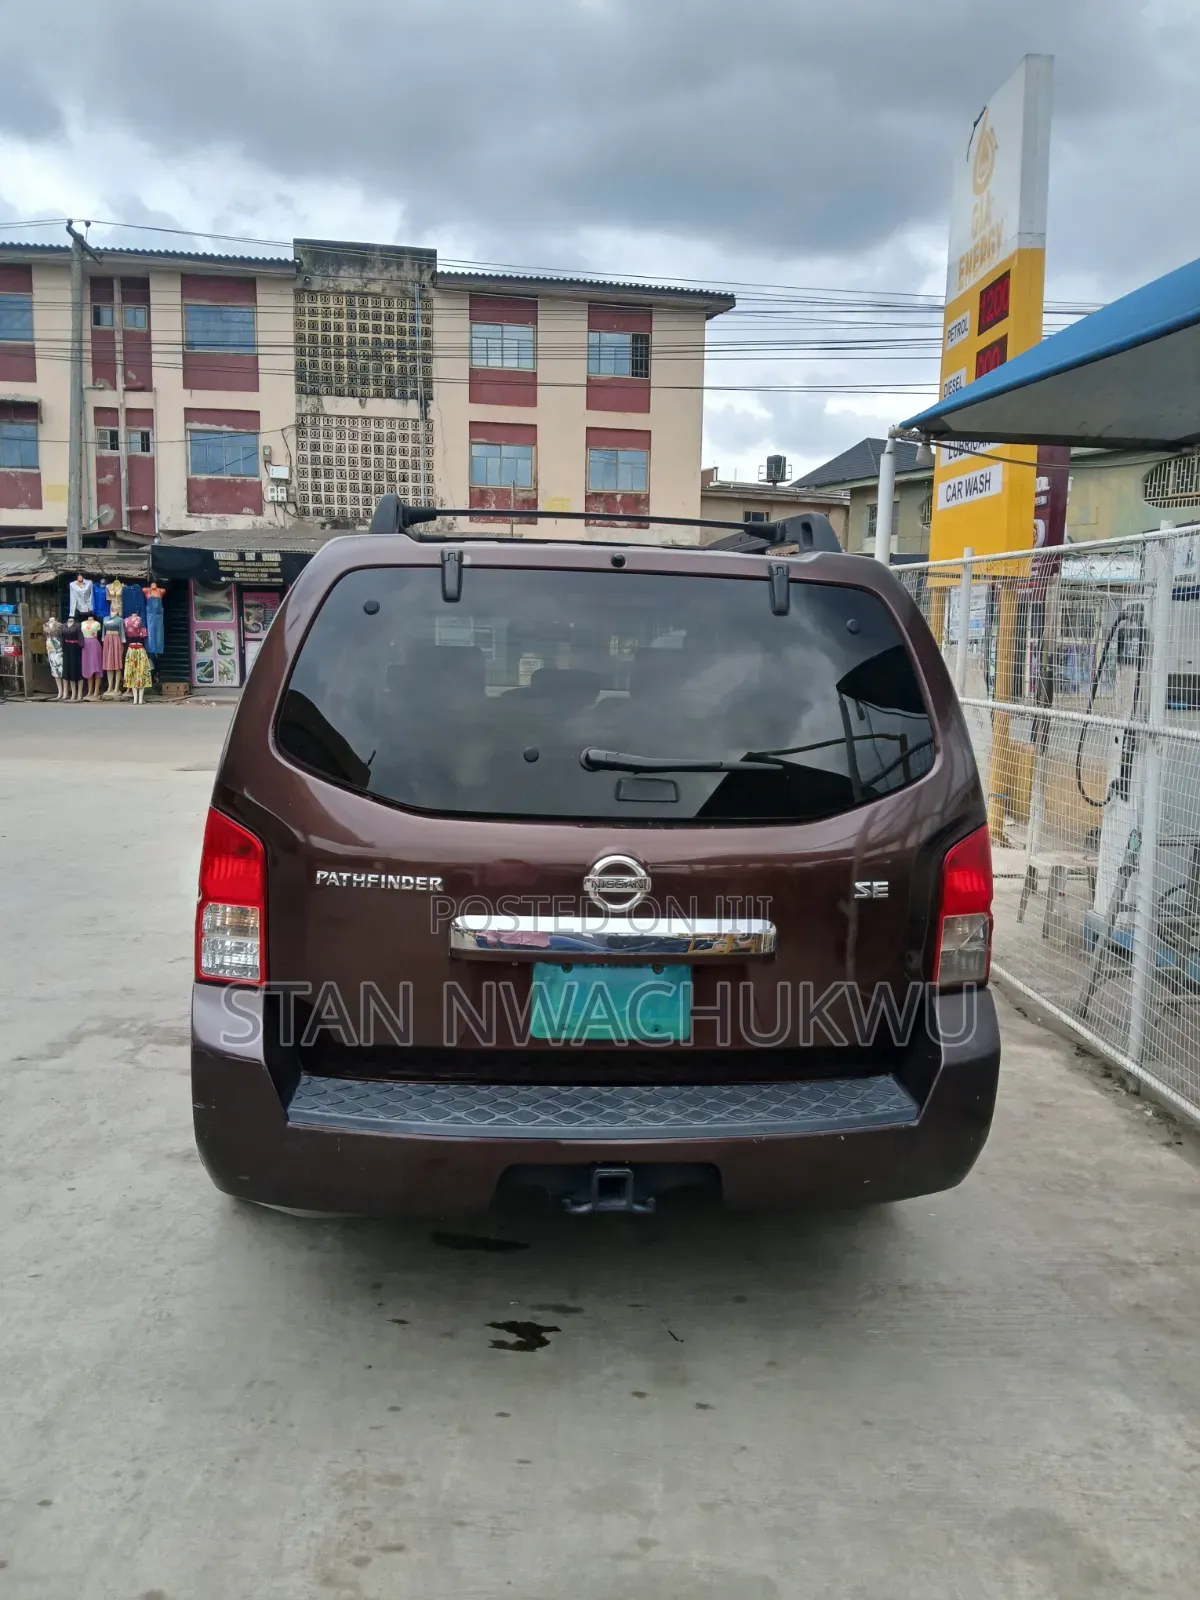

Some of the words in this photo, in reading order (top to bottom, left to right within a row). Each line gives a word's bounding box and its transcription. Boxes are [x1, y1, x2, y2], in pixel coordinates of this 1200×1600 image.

[947, 317, 969, 342] PETROL
[943, 375, 963, 398] DIESEL
[948, 441, 991, 460] LUBRIC
[946, 482, 963, 503] CAR
[965, 471, 992, 497] WASH
[315, 870, 444, 892] PATHFINDER
[591, 879, 645, 889] NISSAN
[854, 880, 889, 899] SE
